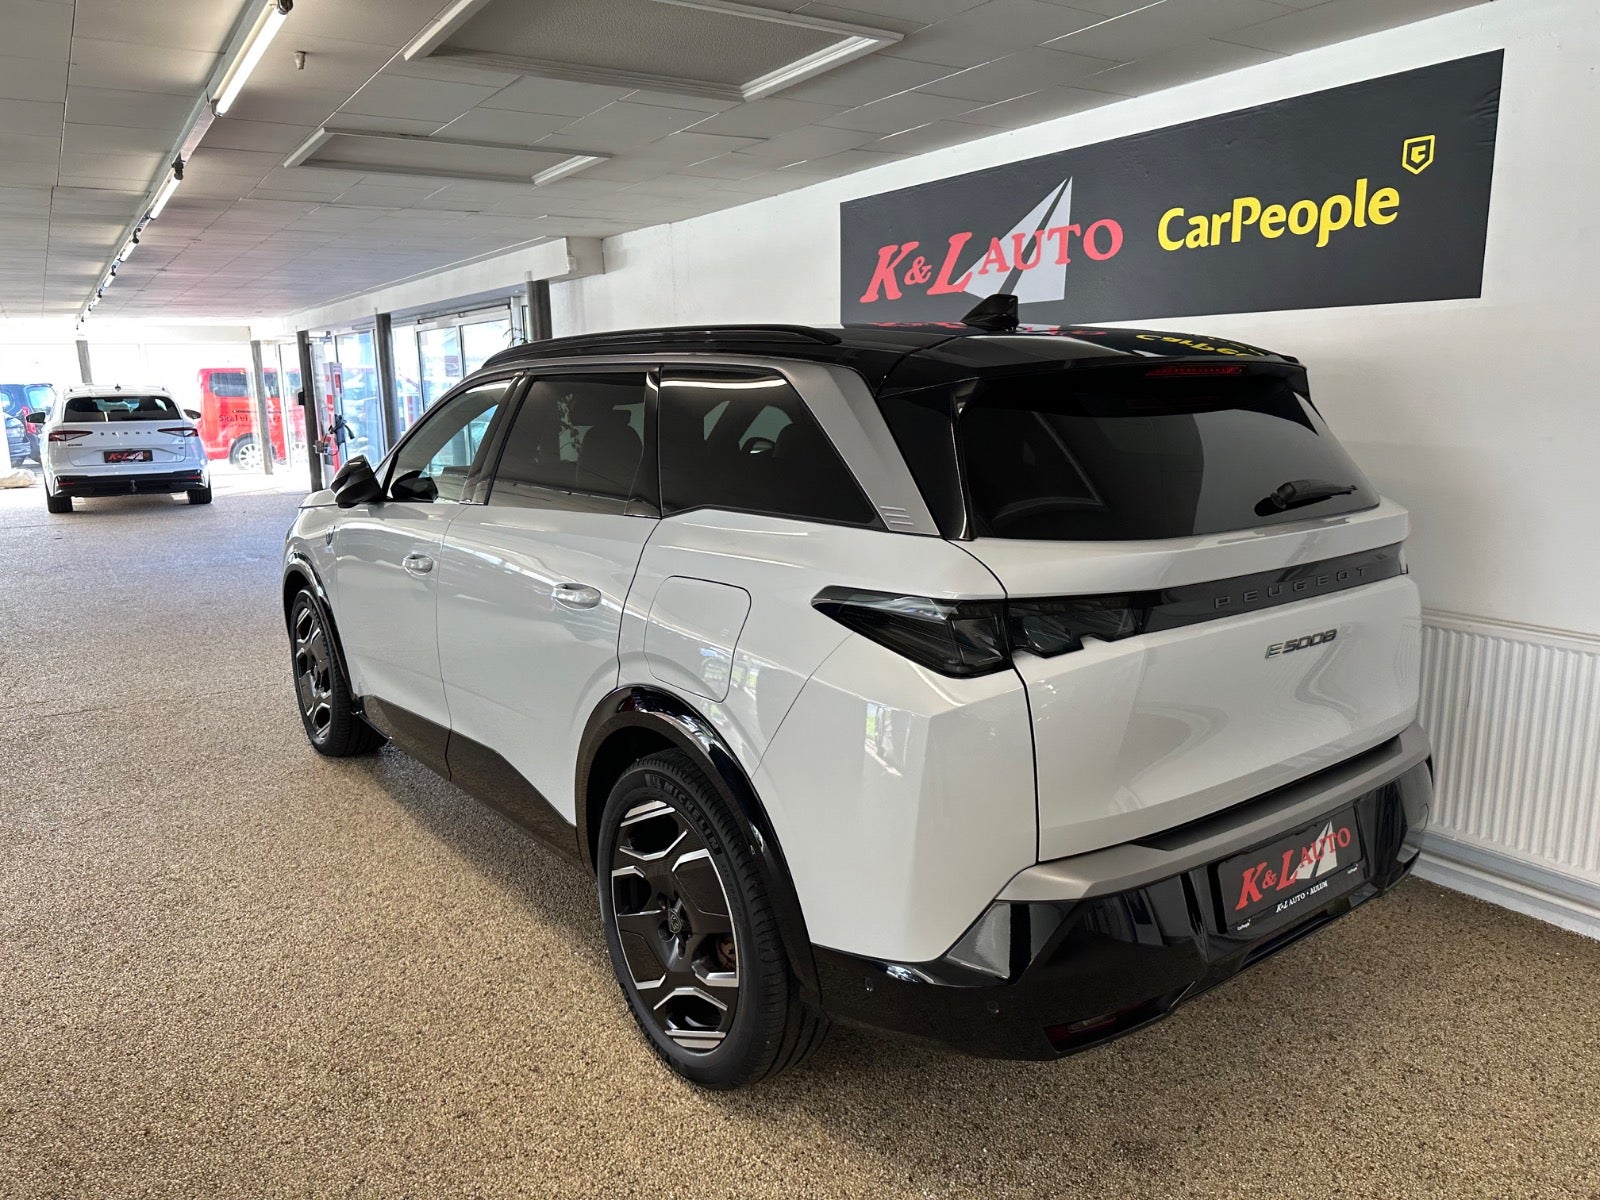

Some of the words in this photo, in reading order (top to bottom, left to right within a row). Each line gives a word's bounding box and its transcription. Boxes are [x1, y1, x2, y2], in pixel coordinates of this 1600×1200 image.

[1156, 177, 1401, 251] CarPeople
[860, 231, 974, 304] K&L
[978, 217, 1124, 278] AUTO
[1215, 567, 1366, 608] PEUGEOT
[664, 784, 722, 856] MICHELIN
[1235, 849, 1299, 910] K&L
[1299, 827, 1351, 867] AUTO
[1289, 893, 1306, 905] AUTO
